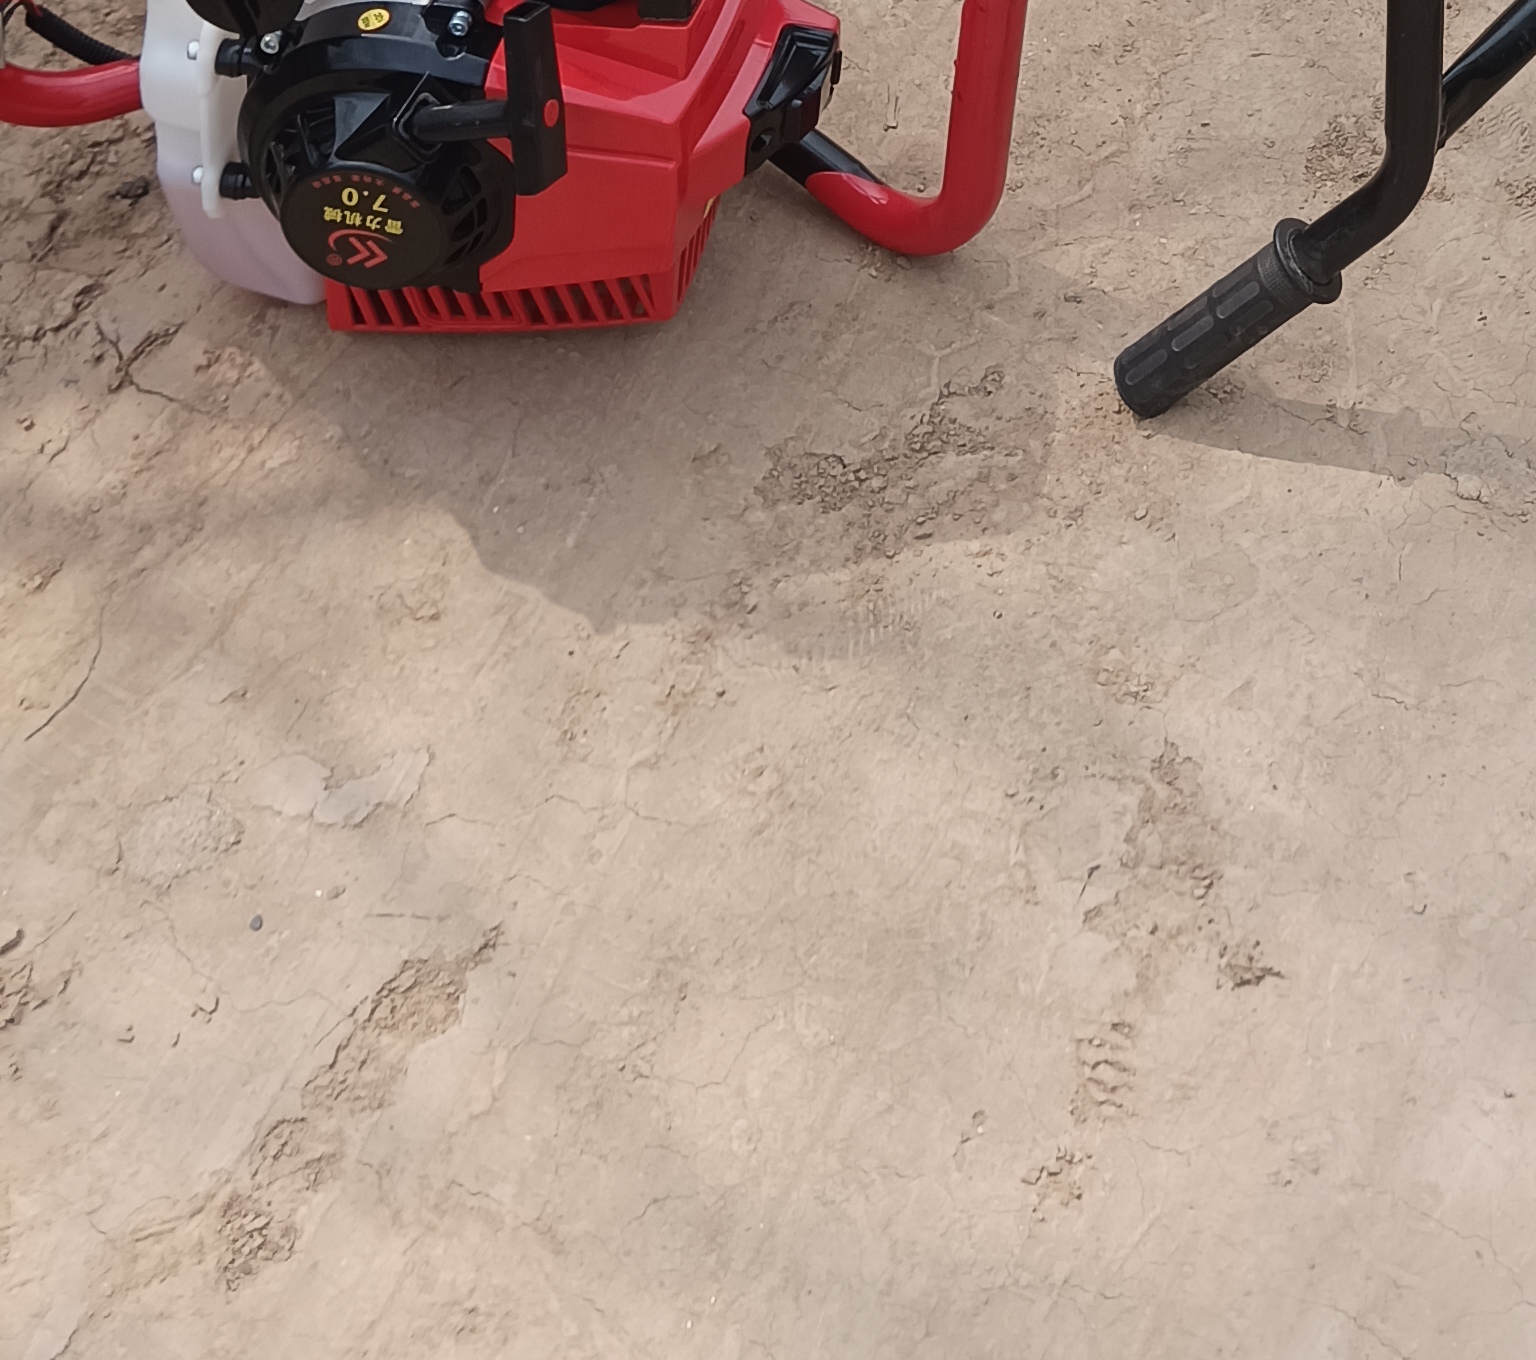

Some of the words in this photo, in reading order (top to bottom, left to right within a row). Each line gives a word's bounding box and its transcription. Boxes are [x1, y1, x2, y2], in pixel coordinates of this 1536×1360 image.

[341, 187, 389, 213] 7.0
[323, 206, 403, 234] 雷力机械
